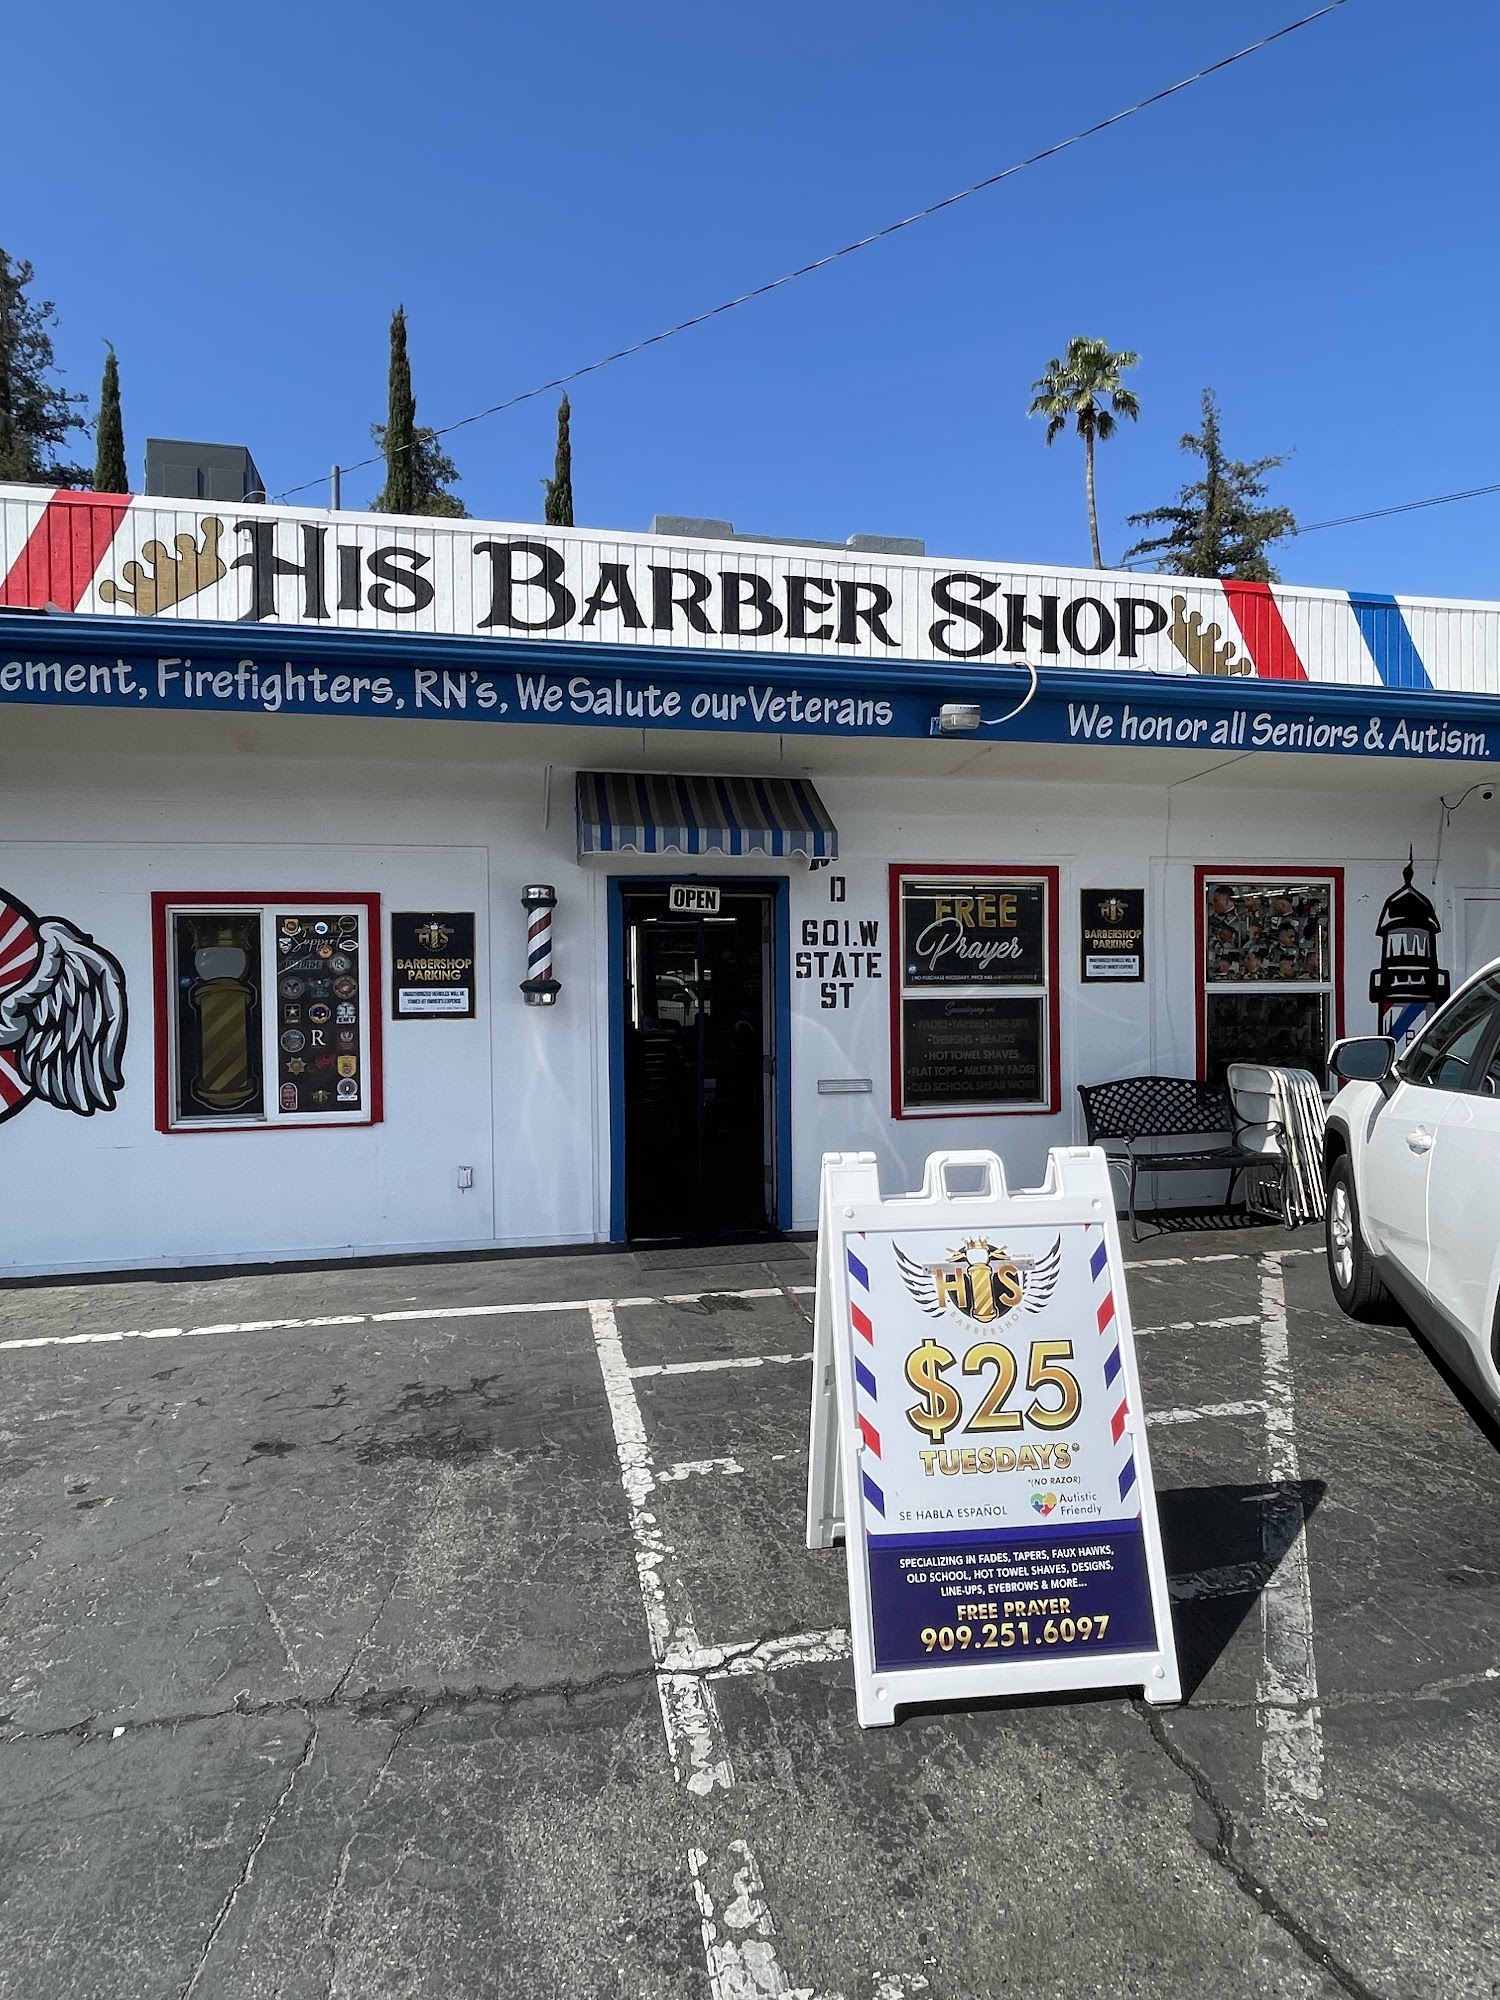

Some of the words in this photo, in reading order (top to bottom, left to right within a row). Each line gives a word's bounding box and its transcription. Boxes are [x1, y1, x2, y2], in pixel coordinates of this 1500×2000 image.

[157, 658, 404, 711] Firefighters,
[414, 669, 508, 714] RN's,
[517, 673, 563, 713] We
[568, 676, 681, 718] Salute
[691, 692, 752, 719] our
[748, 686, 893, 727] Veterans
[1068, 703, 1113, 740] We
[1120, 705, 1208, 744] honor
[1211, 710, 1247, 746] all
[1252, 713, 1359, 749] Seniors
[1363, 716, 1386, 750] &
[1388, 719, 1491, 756] Autism.
[673, 888, 716, 910] OPEN
[934, 894, 1018, 928] FREE
[915, 917, 1024, 971] Prayer
[1084, 929, 1142, 939] BARBERSHOP
[1092, 939, 1134, 950] PARKING
[396, 958, 473, 970] BARBERSHOP
[795, 951, 882, 979] STATE
[407, 970, 462, 981] PARKING
[820, 982, 854, 1009] ST
[311, 1029, 326, 1046] R
[928, 1050, 948, 1061] HOT
[950, 1050, 982, 1060] TOWEL
[982, 1050, 1019, 1060] SHAVES
[1007, 1064, 1036, 1074] FADES
[950, 1305, 1024, 1337] BARBERSHOP
[904, 1338, 1082, 1445] $25
[1050, 1475, 1081, 1486] RAZOR)
[1060, 1492, 1097, 1503] Autistic
[899, 1511, 912, 1521] SE
[916, 1509, 954, 1520] HABLA
[957, 1502, 1008, 1518] ESPAÑOL
[1061, 1504, 1102, 1516] Friendly
[900, 1555, 964, 1569] SPECIALIZING
[966, 1554, 976, 1564] IN
[978, 1552, 1011, 1564] FADES,
[1013, 1550, 1050, 1562] TAPERS,
[1052, 1548, 1076, 1559] FAUX
[1078, 1545, 1115, 1557] HAWKS,
[906, 1572, 927, 1584] OLD
[930, 1570, 972, 1583] SCHOOL,
[974, 1568, 994, 1580] HOT
[996, 1566, 1030, 1578] TOWEL
[1031, 1564, 1070, 1576] SHAVES,
[1072, 1560, 1114, 1573] DESIGNS,
[940, 1584, 986, 1597] LINE-UPS,
[988, 1581, 1039, 1594] EYEBROWS
[1041, 1580, 1049, 1590] &
[1051, 1578, 1088, 1589] MORE...
[956, 1602, 998, 1622] FREE
[1004, 1598, 1072, 1618] PRAYER
[920, 1615, 1110, 1652] 909.251.6097
